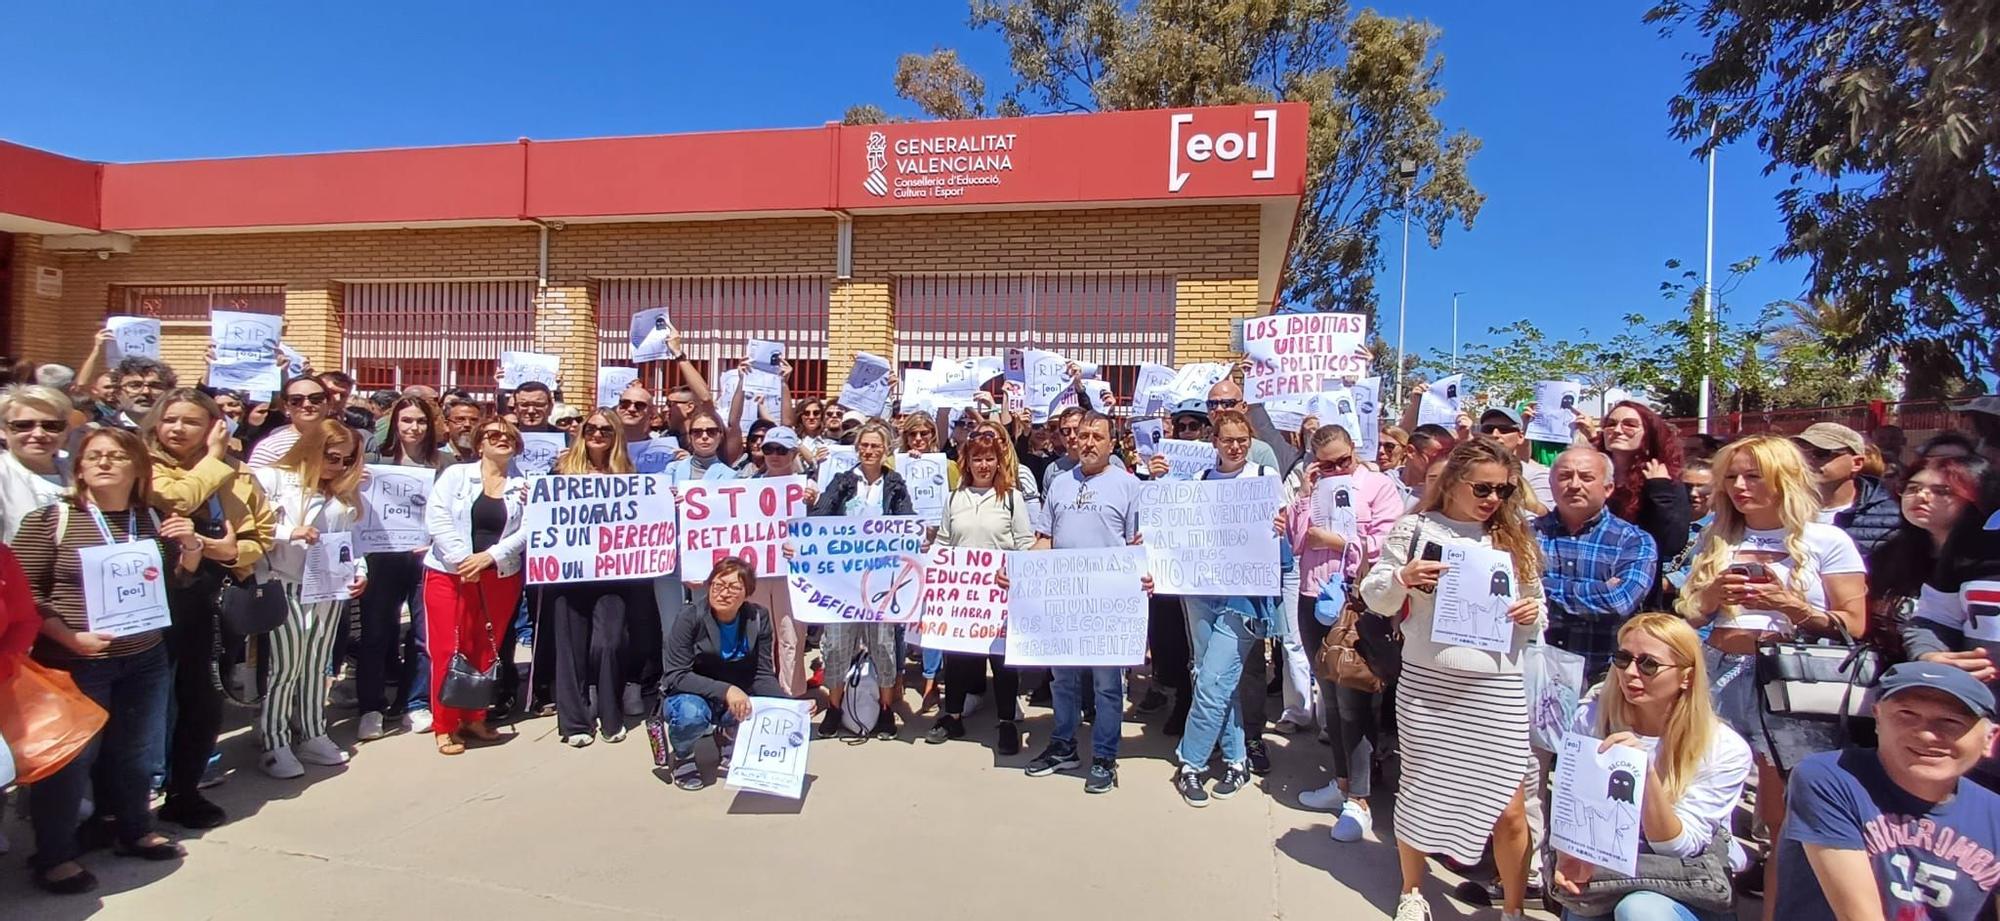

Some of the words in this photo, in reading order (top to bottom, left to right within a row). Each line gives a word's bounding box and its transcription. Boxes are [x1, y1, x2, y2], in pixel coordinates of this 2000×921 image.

[895, 134, 1016, 155] GENERALITAT
[896, 155, 1012, 174] VALENCIANA
[894, 176, 945, 187] Conselleria
[894, 189, 927, 198] Cultura
[935, 187, 964, 199] Esport
[1247, 319, 1278, 341] LOS
[1287, 315, 1361, 335] IDIOMAS
[1281, 354, 1361, 373] POLITICOS
[532, 475, 656, 503] APRENDER
[1140, 482, 1210, 506] CADA
[685, 484, 804, 520] STOP
[552, 501, 638, 525] IDIOMAS
[1140, 506, 1162, 528] ES
[1168, 506, 1205, 527] UNA
[530, 527, 558, 549] ES
[566, 526, 591, 547] UN
[599, 521, 675, 554] DERECHO
[788, 522, 812, 537] NO
[819, 526, 828, 536] A
[833, 525, 856, 535] LOS
[863, 519, 925, 536] CORTES
[1153, 530, 1181, 549] AL
[1188, 528, 1248, 549] MUNDO
[800, 543, 818, 555] LA
[967, 549, 993, 567] NO
[1199, 549, 1227, 560] LOS
[529, 555, 560, 581] NO
[562, 560, 584, 579] UN
[789, 560, 810, 574] NO
[817, 561, 835, 574] SE
[1008, 553, 1048, 578] LOS
[1053, 552, 1137, 575] IDIOMAS
[1154, 558, 1185, 588] NO
[1191, 560, 1280, 590] RECORTES
[966, 590, 980, 601] EL
[1012, 577, 1090, 599] ABREN
[808, 590, 885, 621] DEFIENDE
[927, 605, 944, 617] NO
[951, 605, 992, 620] HABRA
[1045, 597, 1140, 616] MUNDOS
[909, 622, 949, 637] PARA
[953, 627, 966, 639] EL
[1051, 615, 1146, 634] RECORTES
[1079, 633, 1146, 657] MENTES
